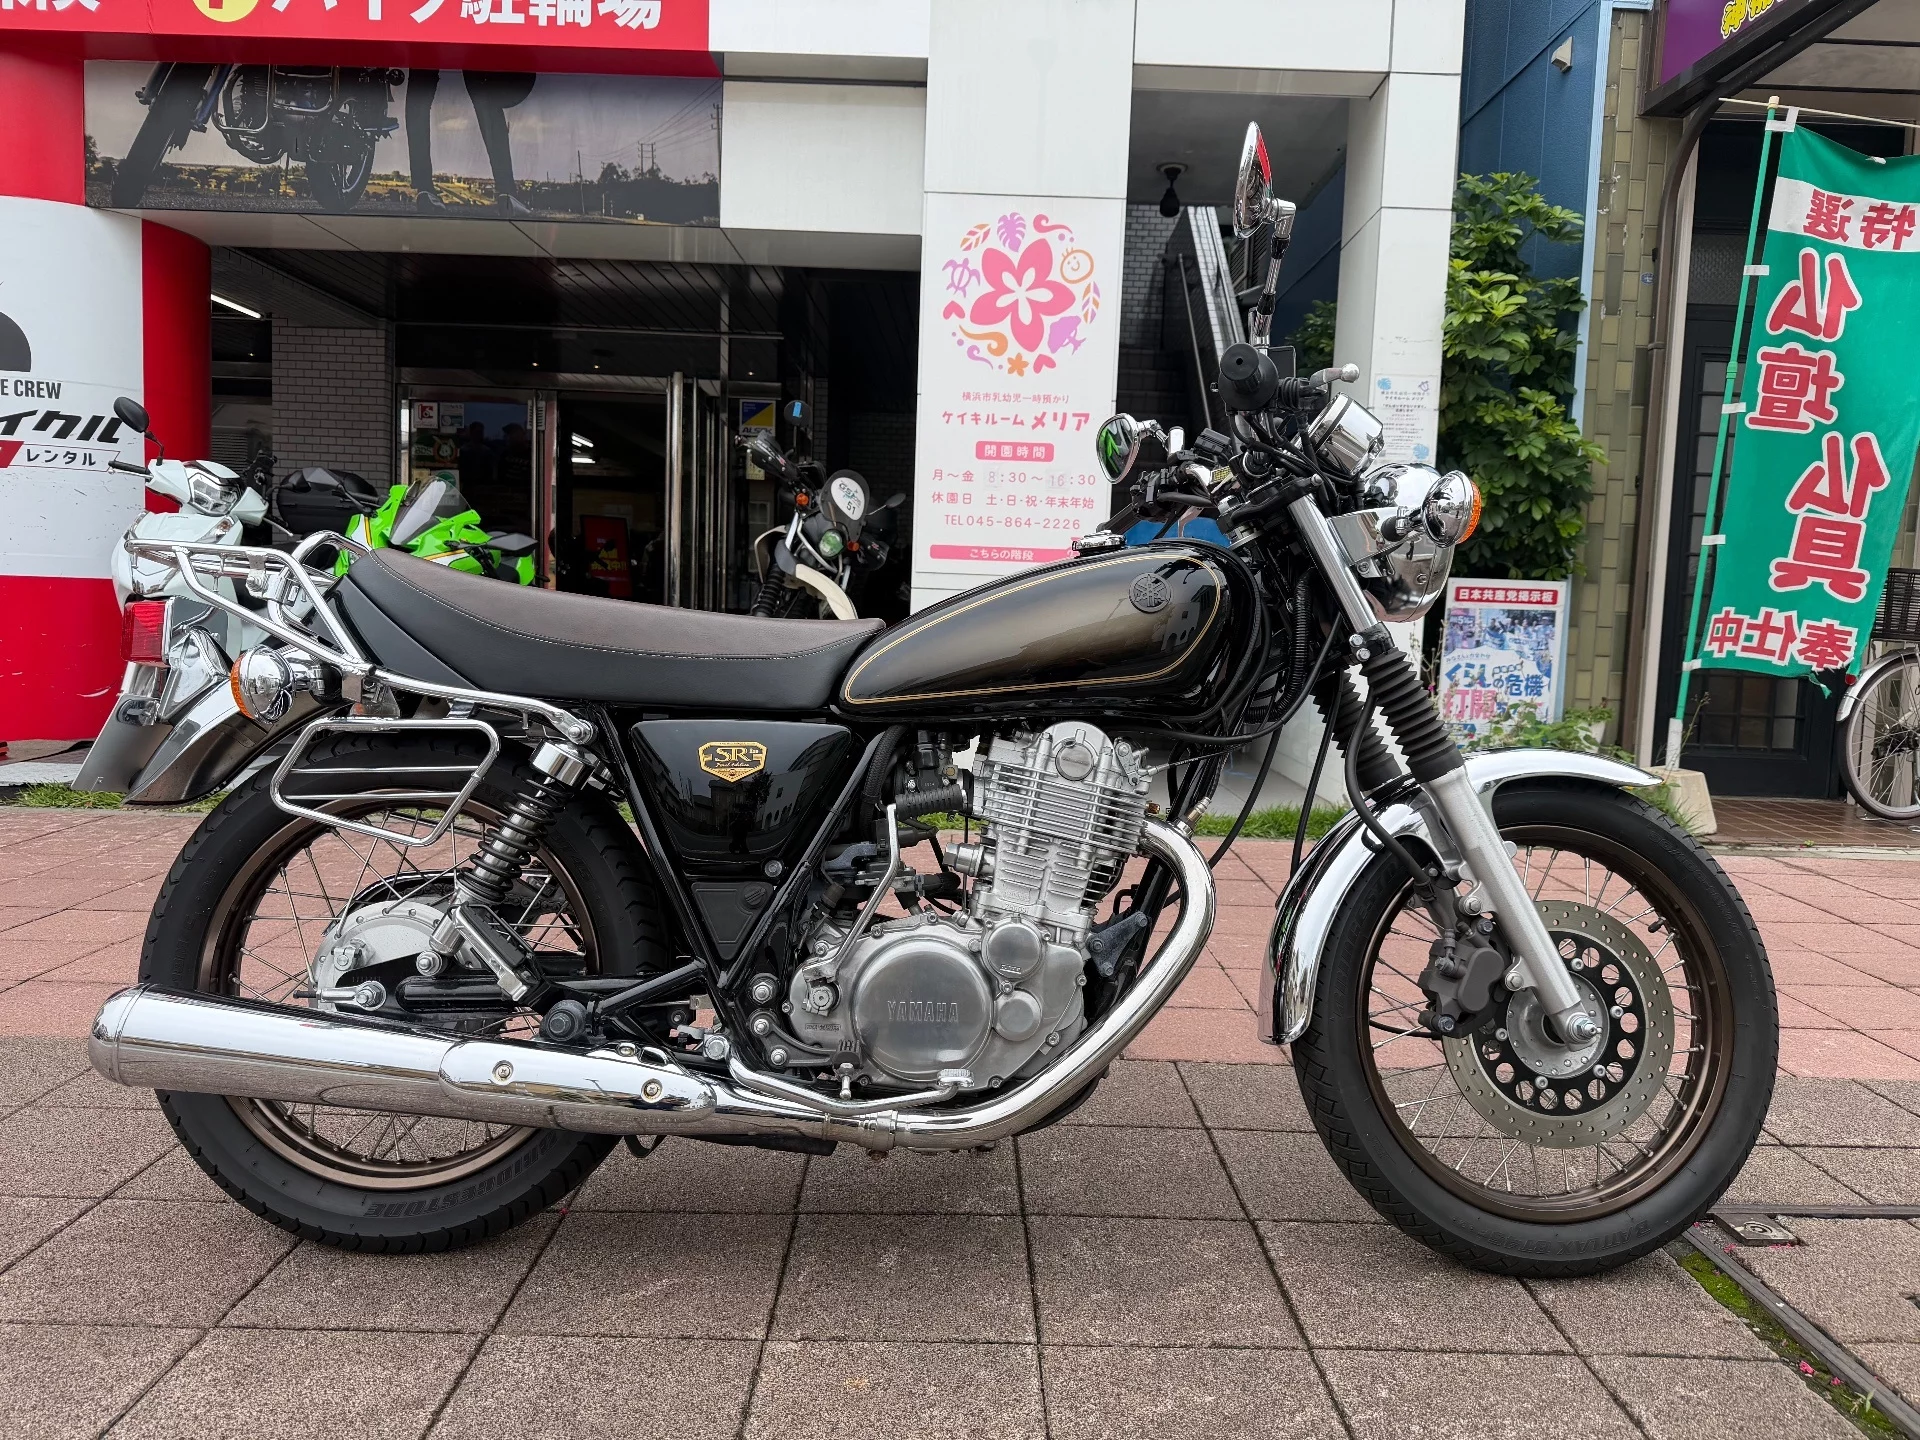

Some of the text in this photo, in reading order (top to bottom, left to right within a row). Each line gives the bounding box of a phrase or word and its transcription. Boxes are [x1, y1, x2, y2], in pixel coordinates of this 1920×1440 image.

[14, 380, 61, 399] CREW
[962, 392, 1070, 404] 横浜市乳幼児一時預かり
[942, 411, 1090, 431] ケイキルーム メリア
[26, 448, 96, 466] レンタル
[984, 444, 1045, 459] 開園時間
[932, 491, 972, 505] 休園日
[969, 549, 1034, 561] こちらの階段
[1458, 588, 1553, 603] 日本共産党掲示板
[887, 1000, 959, 1023] YAMAHA
